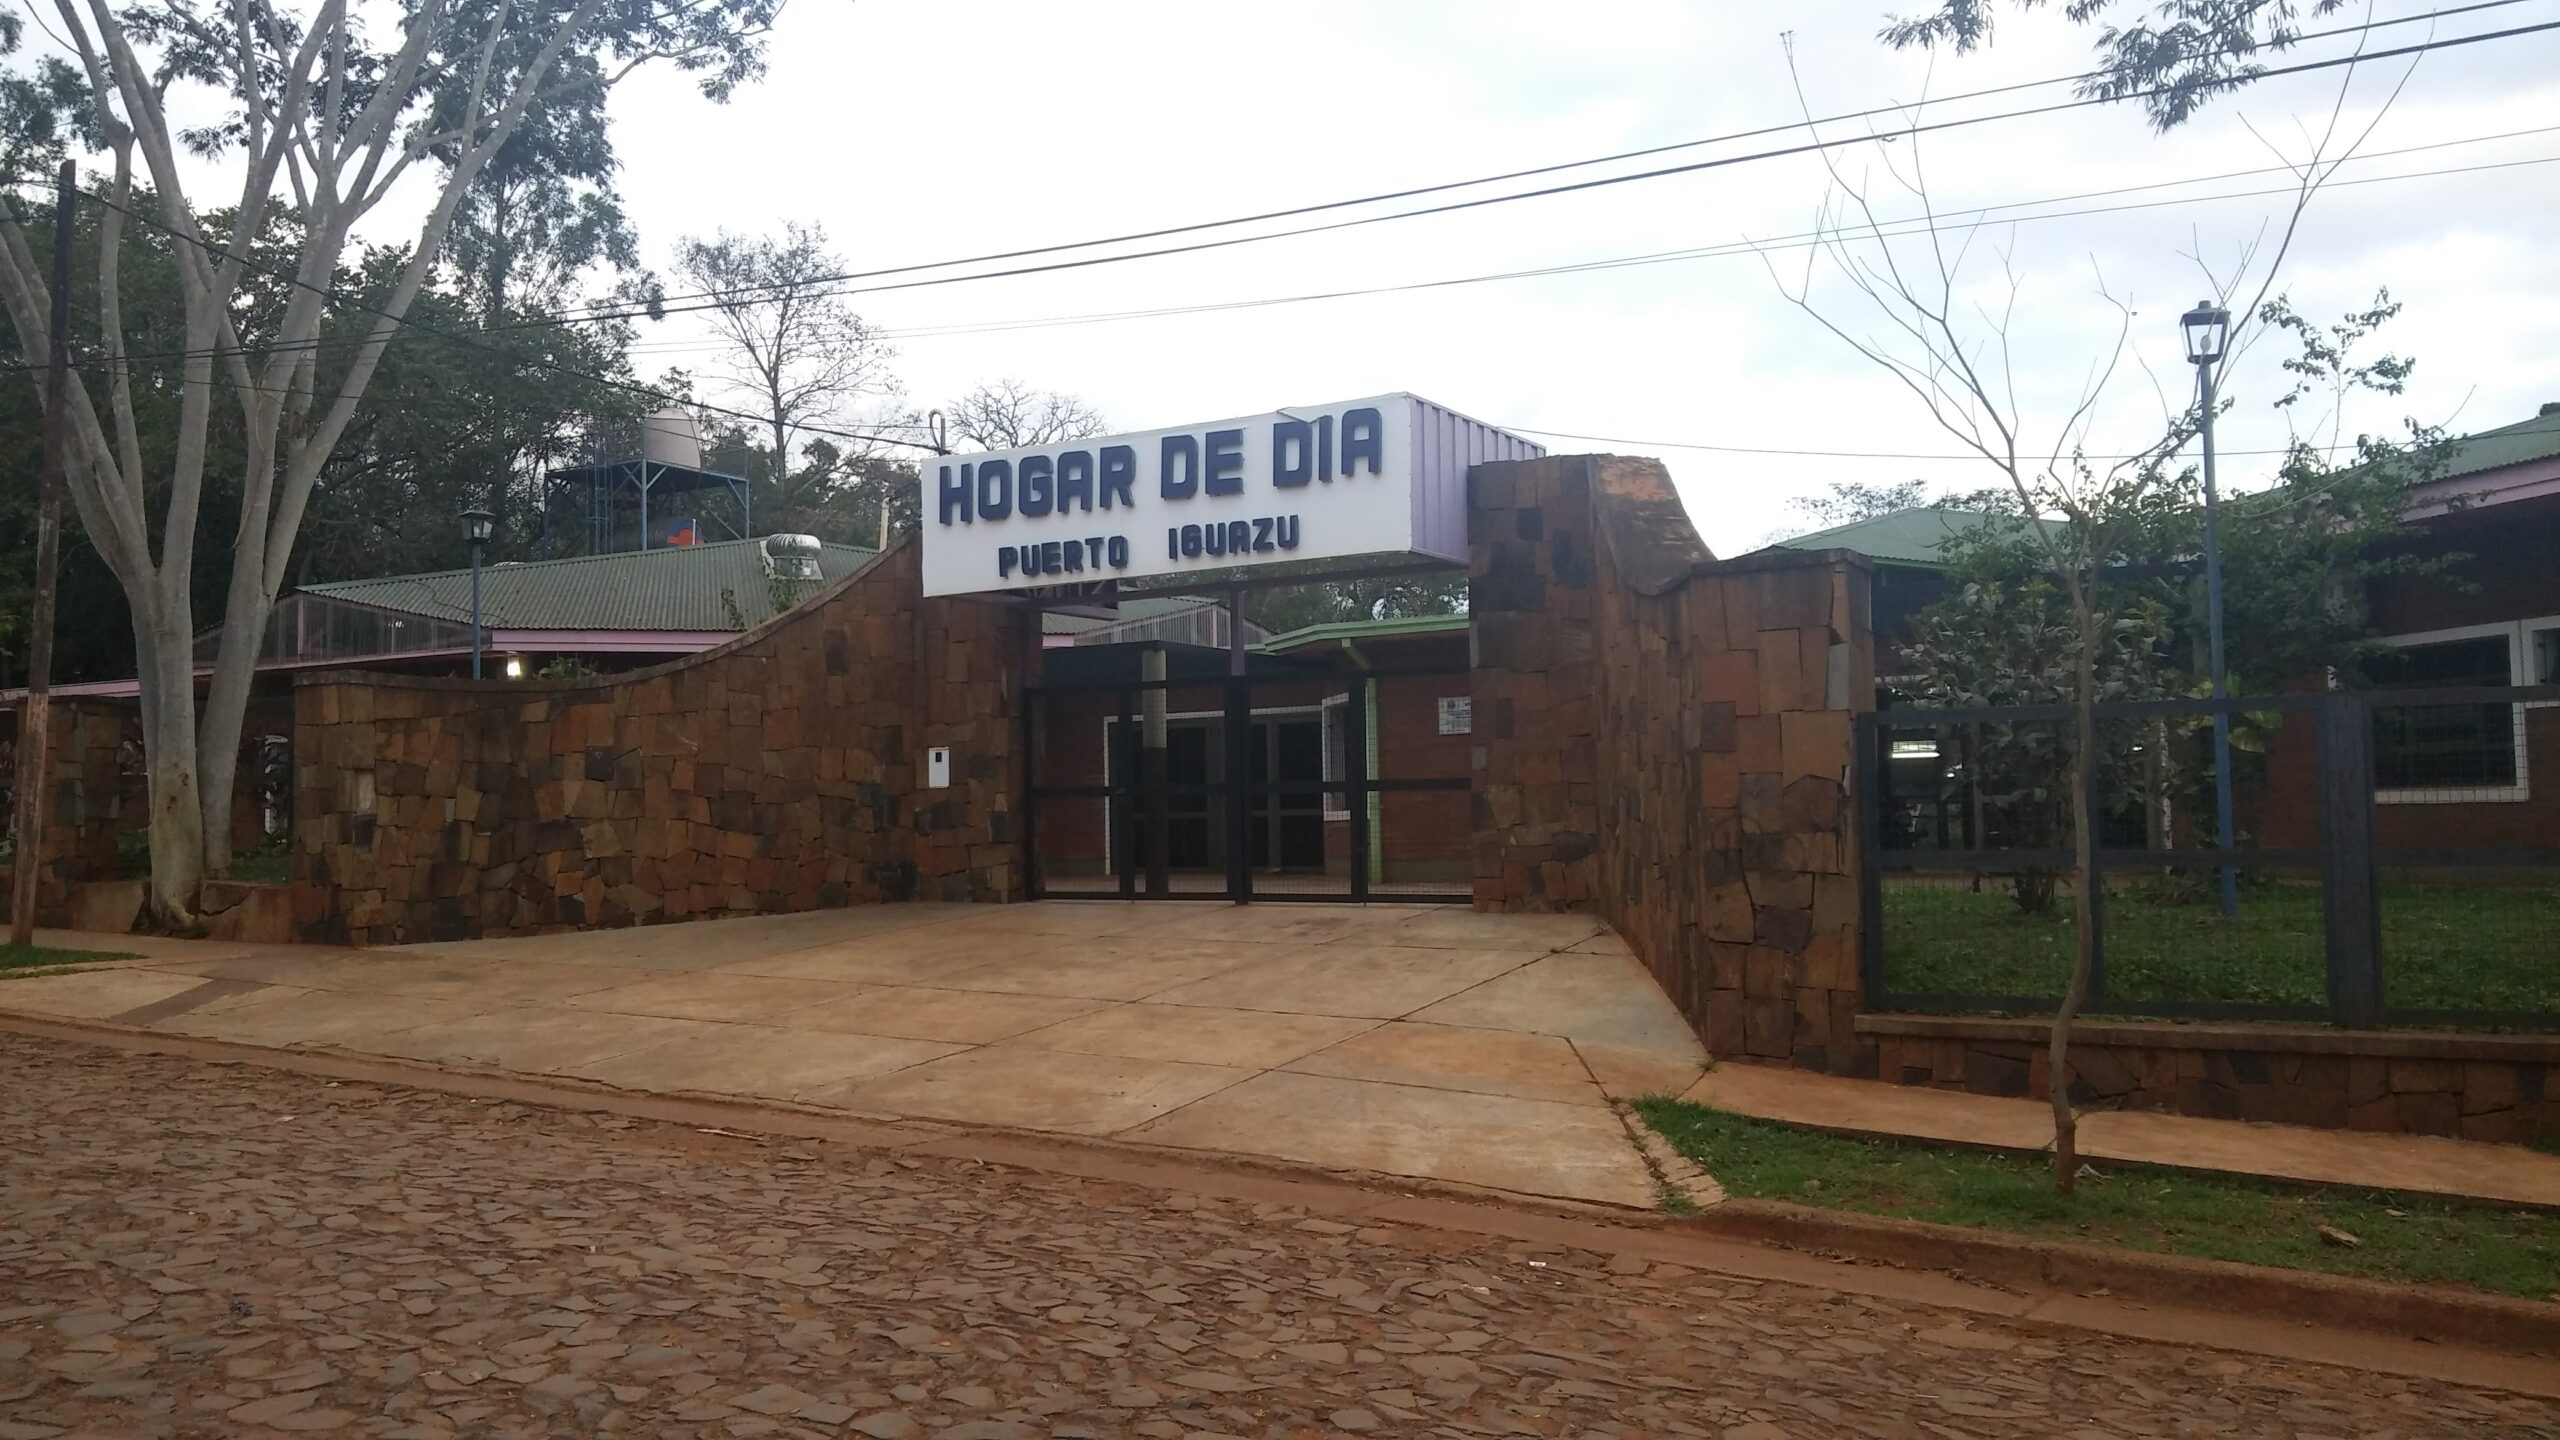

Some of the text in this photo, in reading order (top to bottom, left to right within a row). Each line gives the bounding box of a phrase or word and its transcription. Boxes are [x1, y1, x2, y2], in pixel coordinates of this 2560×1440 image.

[939, 407, 1382, 525] HOGAR DE DIA
[998, 514, 1300, 580] PUERTO IGUAZU
